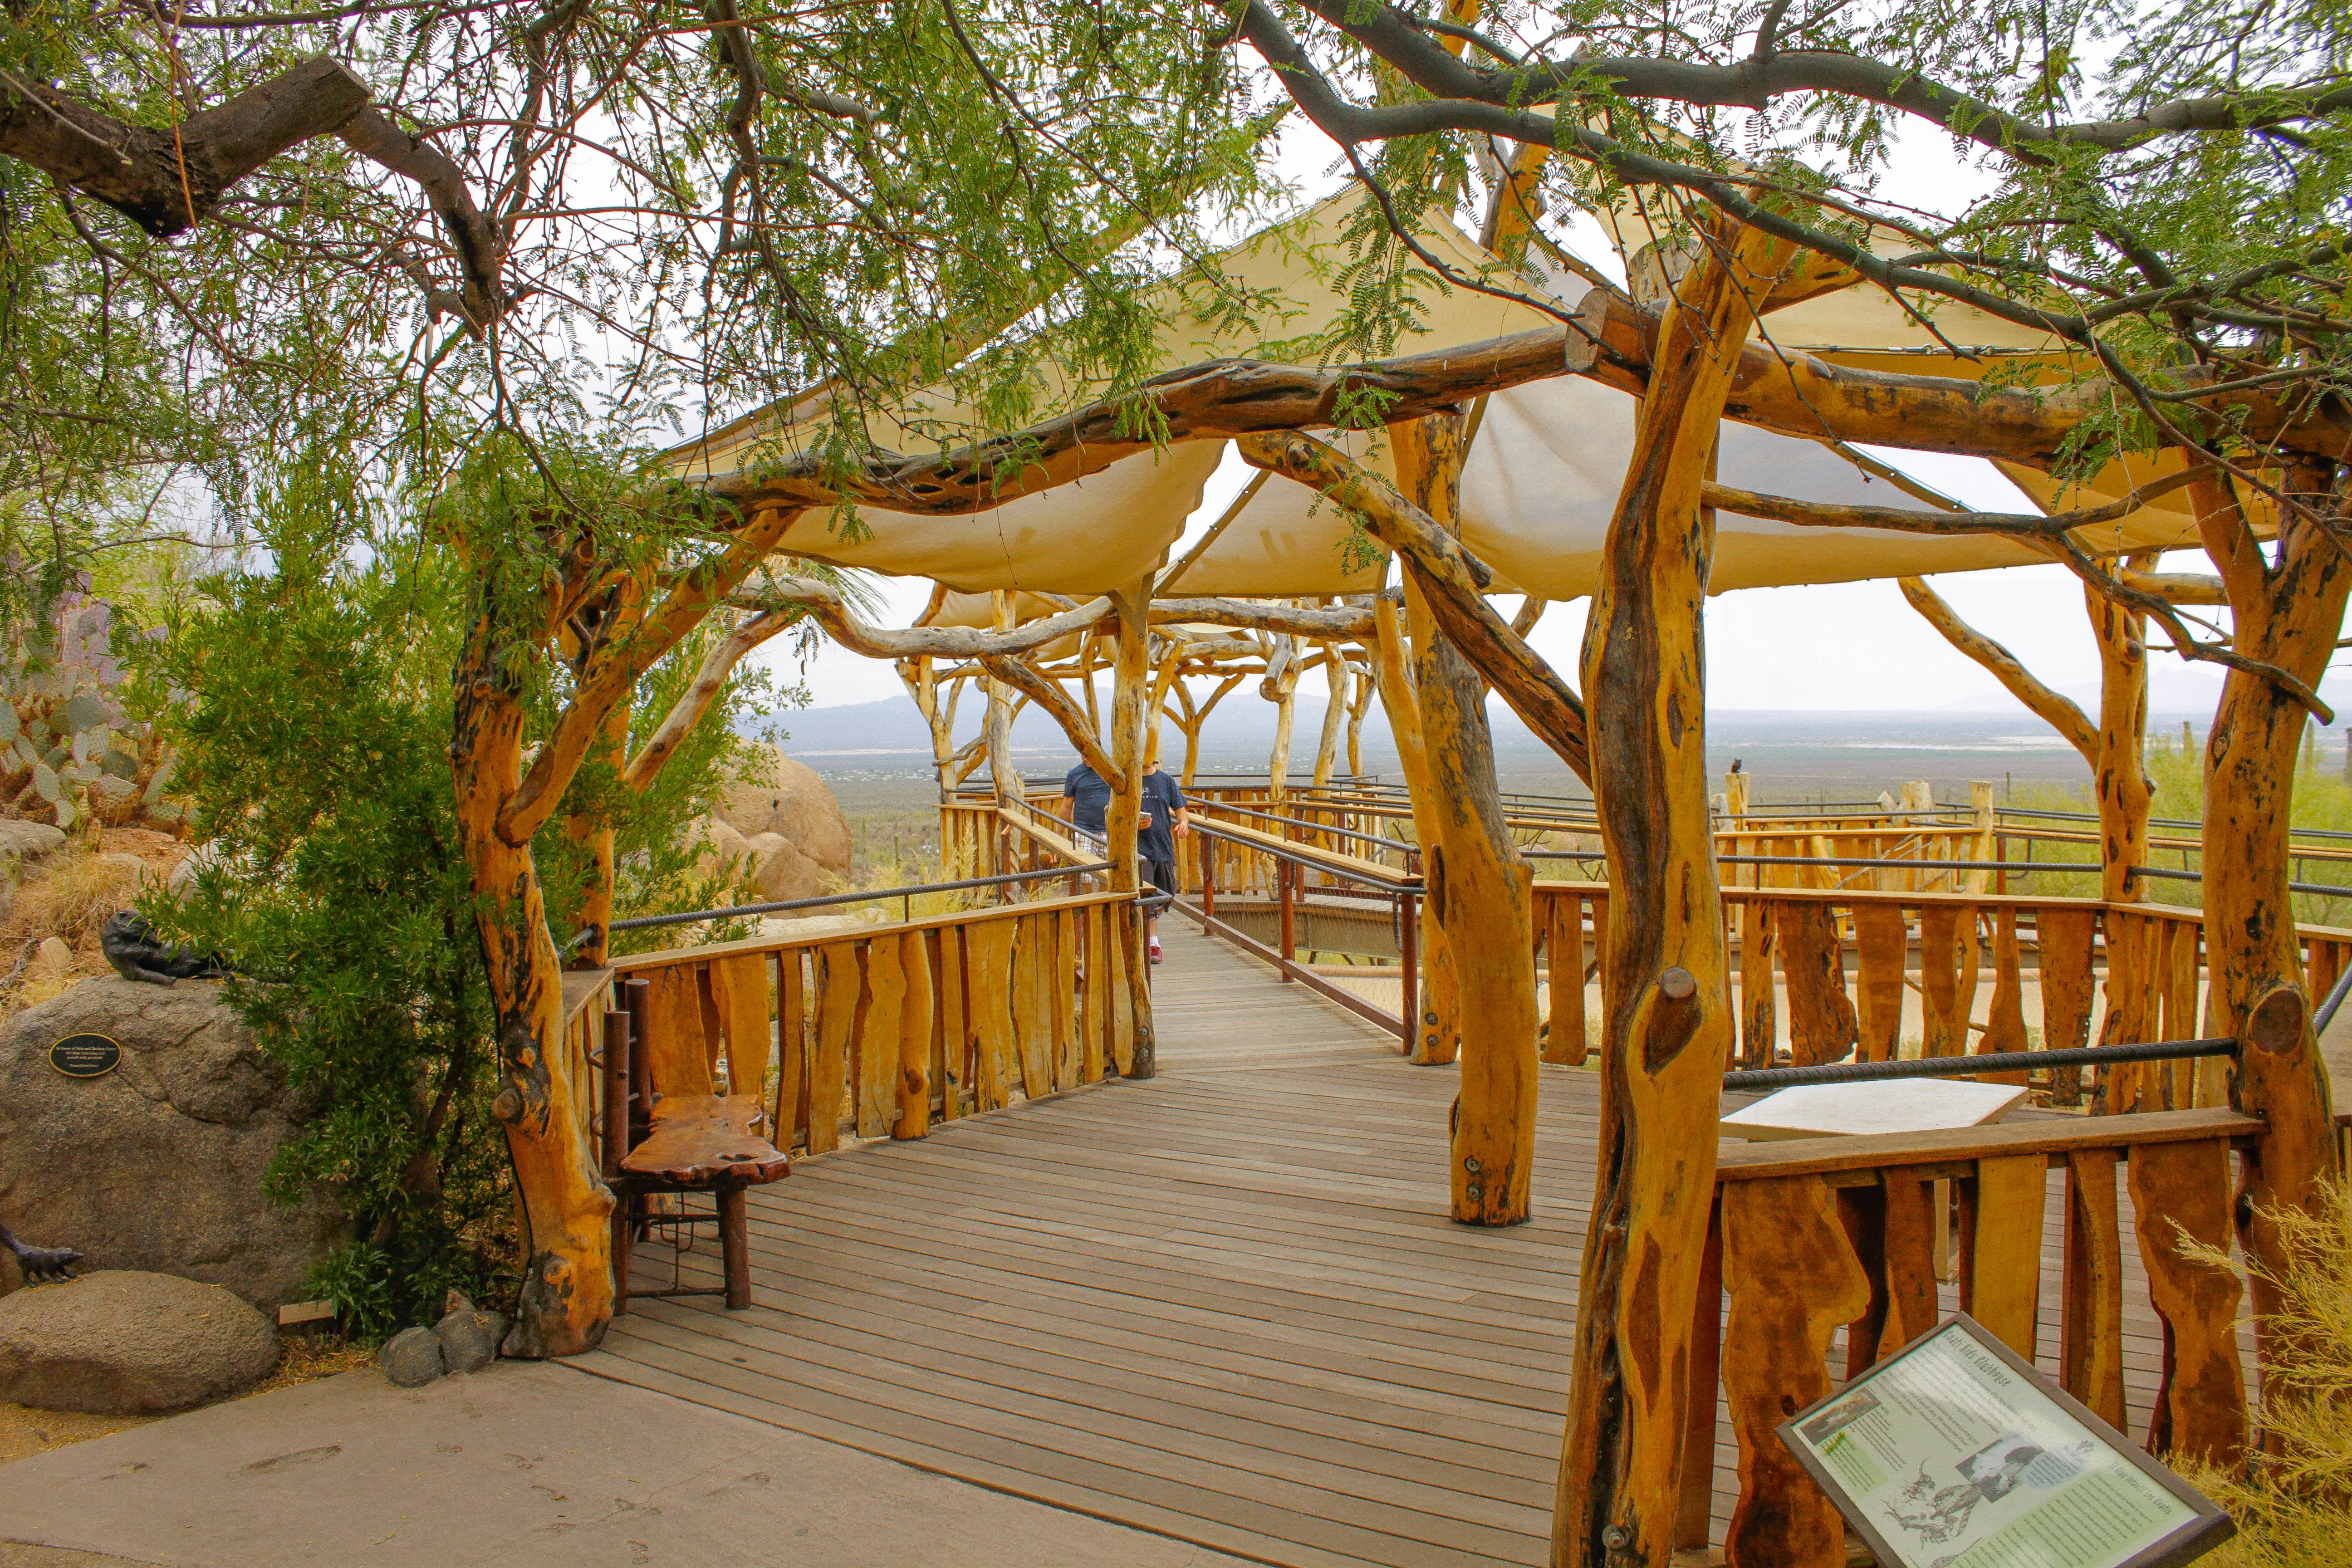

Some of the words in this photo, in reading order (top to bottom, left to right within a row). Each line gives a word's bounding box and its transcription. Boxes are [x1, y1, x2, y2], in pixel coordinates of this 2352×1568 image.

[1942, 1330, 1965, 1348] Coati
[1959, 1343, 1977, 1359] Kids
[1973, 1356, 2012, 1387] Clubhouse
